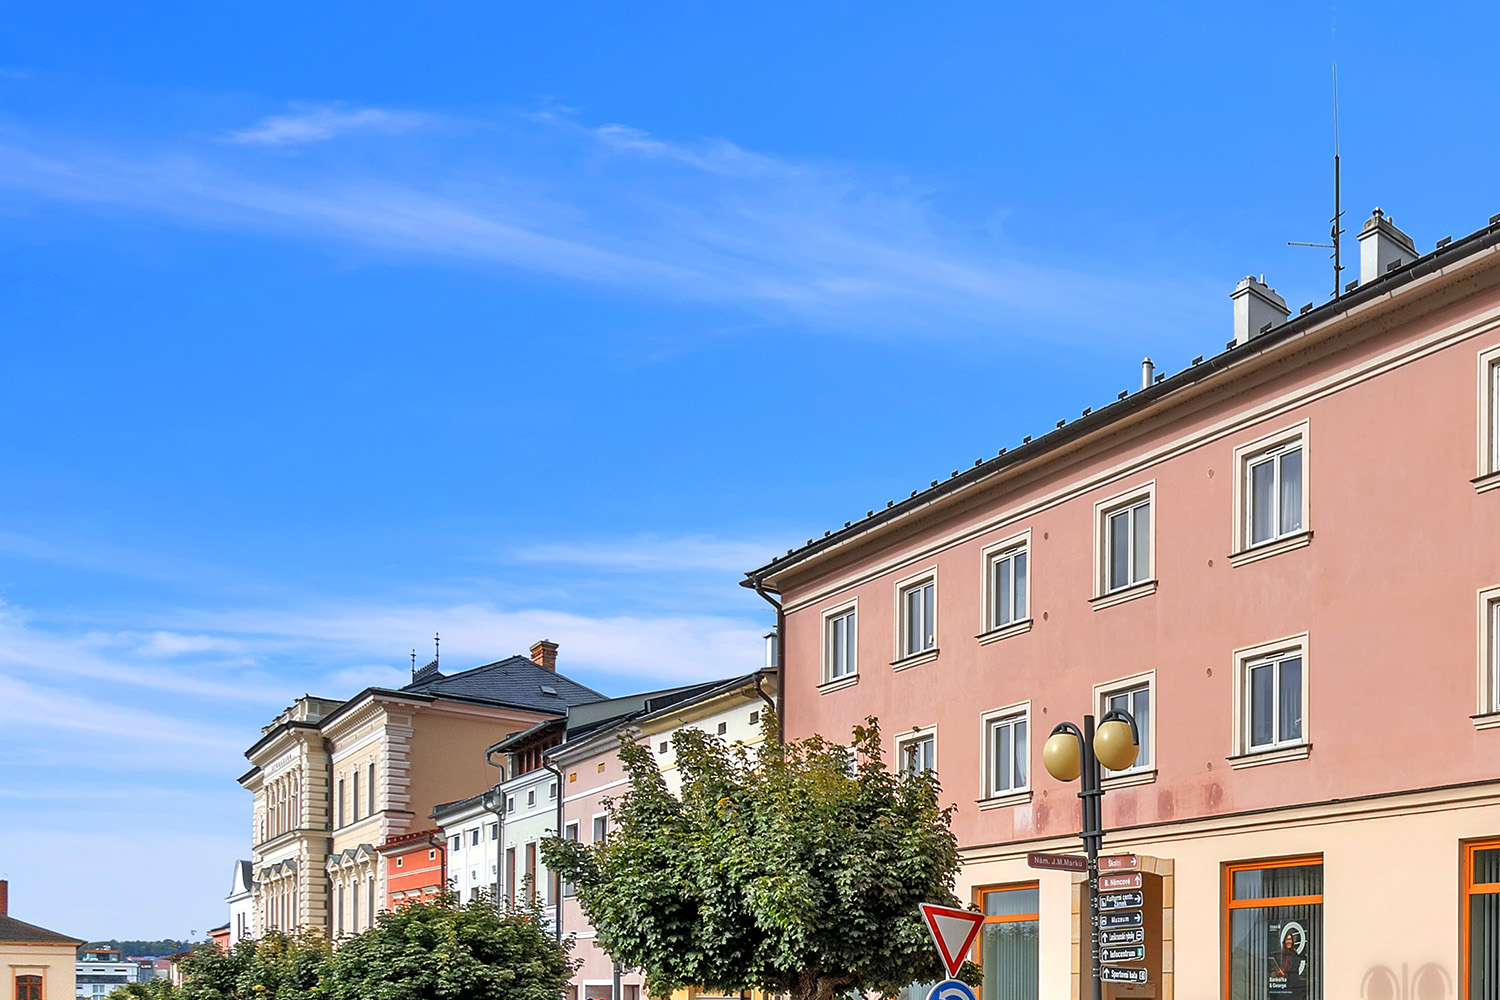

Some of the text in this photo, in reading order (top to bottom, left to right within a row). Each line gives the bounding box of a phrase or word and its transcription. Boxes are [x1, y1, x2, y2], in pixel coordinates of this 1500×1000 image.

[1034, 856, 1050, 865] Nám.
[1108, 858, 1122, 867] Školní
[1104, 878, 1131, 887] B. Němcové
[1110, 949, 1136, 958] Infocentrum
